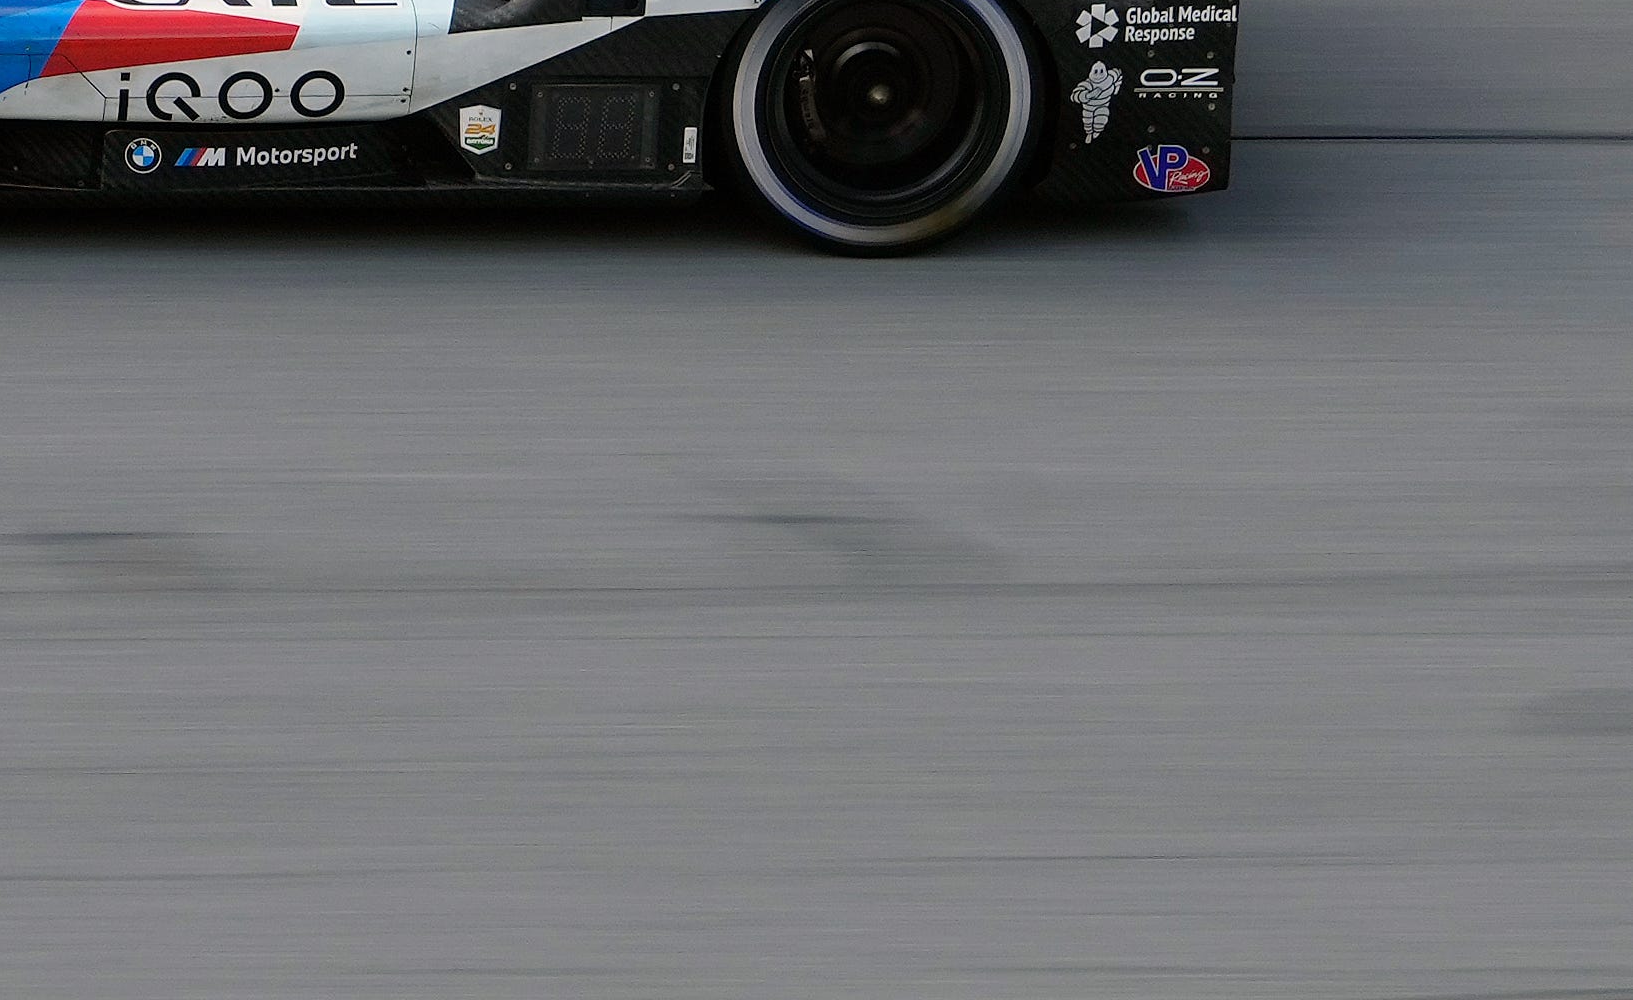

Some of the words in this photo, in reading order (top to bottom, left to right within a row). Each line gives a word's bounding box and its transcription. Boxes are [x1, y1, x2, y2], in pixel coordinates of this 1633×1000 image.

[1126, 5, 1175, 24] Global
[1178, 4, 1238, 23] Medical
[1125, 25, 1195, 45] Response
[117, 70, 346, 121] iQOO
[236, 142, 358, 166] Motorsport
[1137, 145, 1189, 191] VP
[1168, 170, 1209, 187] Racing
